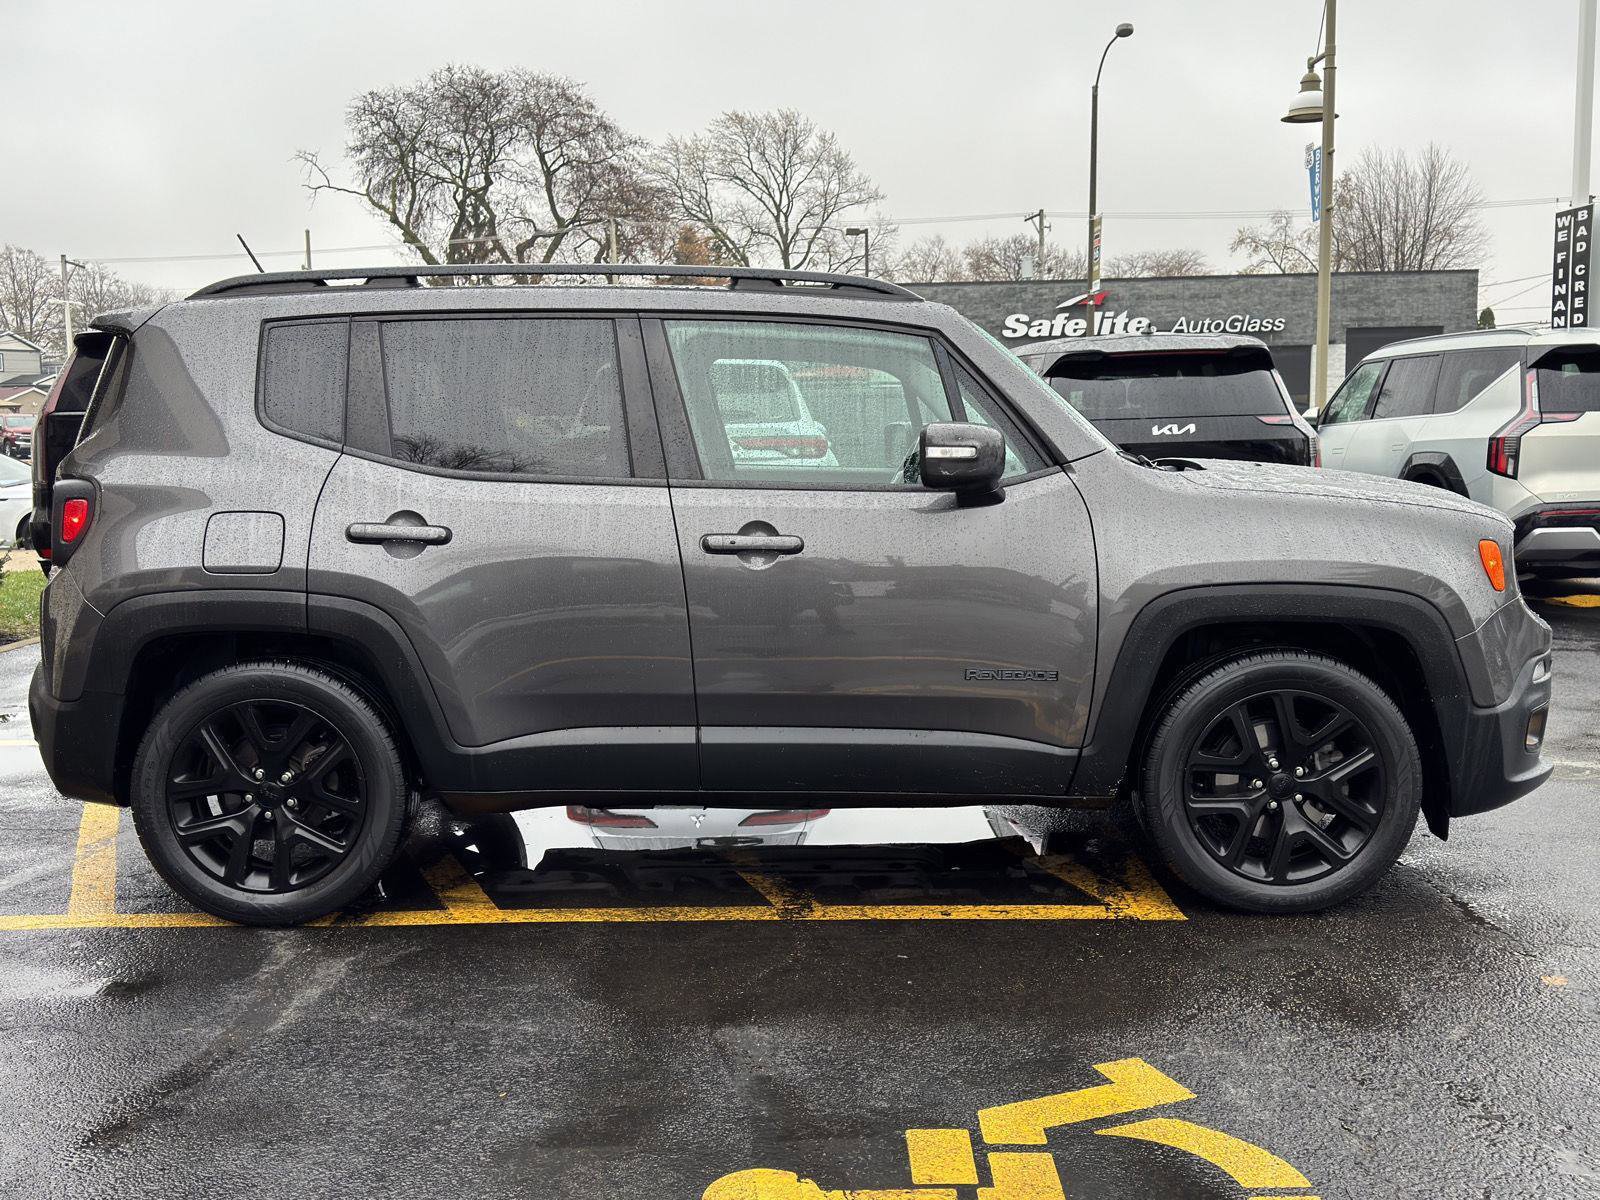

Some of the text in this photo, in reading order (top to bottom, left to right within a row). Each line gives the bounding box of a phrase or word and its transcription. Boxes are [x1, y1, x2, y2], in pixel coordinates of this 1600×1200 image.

[1553, 215, 1571, 327] WE FINAN
[1574, 209, 1588, 325] BAD CRED
[1002, 310, 1286, 338] Safelite AutoGlass
[1151, 423, 1196, 436] KIA
[964, 668, 1058, 681] RENEGADE
